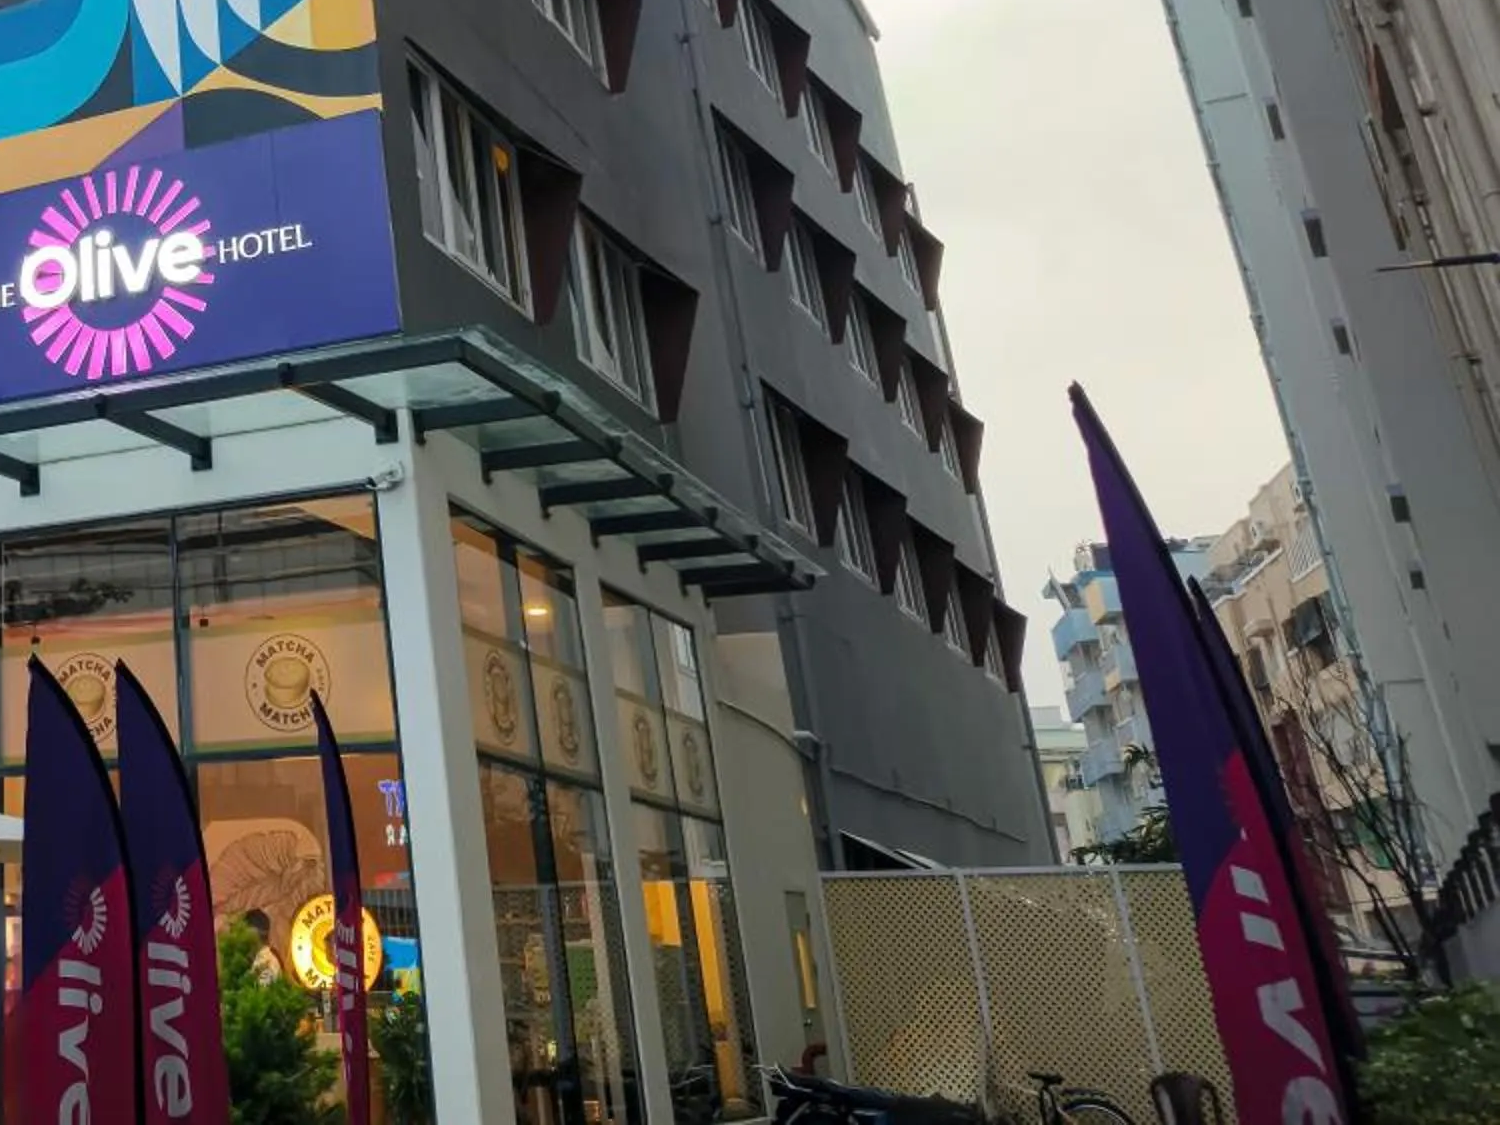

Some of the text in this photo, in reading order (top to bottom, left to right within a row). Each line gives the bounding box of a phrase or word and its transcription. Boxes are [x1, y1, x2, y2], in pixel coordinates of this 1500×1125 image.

[20, 228, 204, 308] Olive
[219, 224, 313, 264] HOTEL
[256, 640, 315, 667] MATCHA
[59, 660, 111, 683] MATCHA
[260, 701, 316, 725] MATCH
